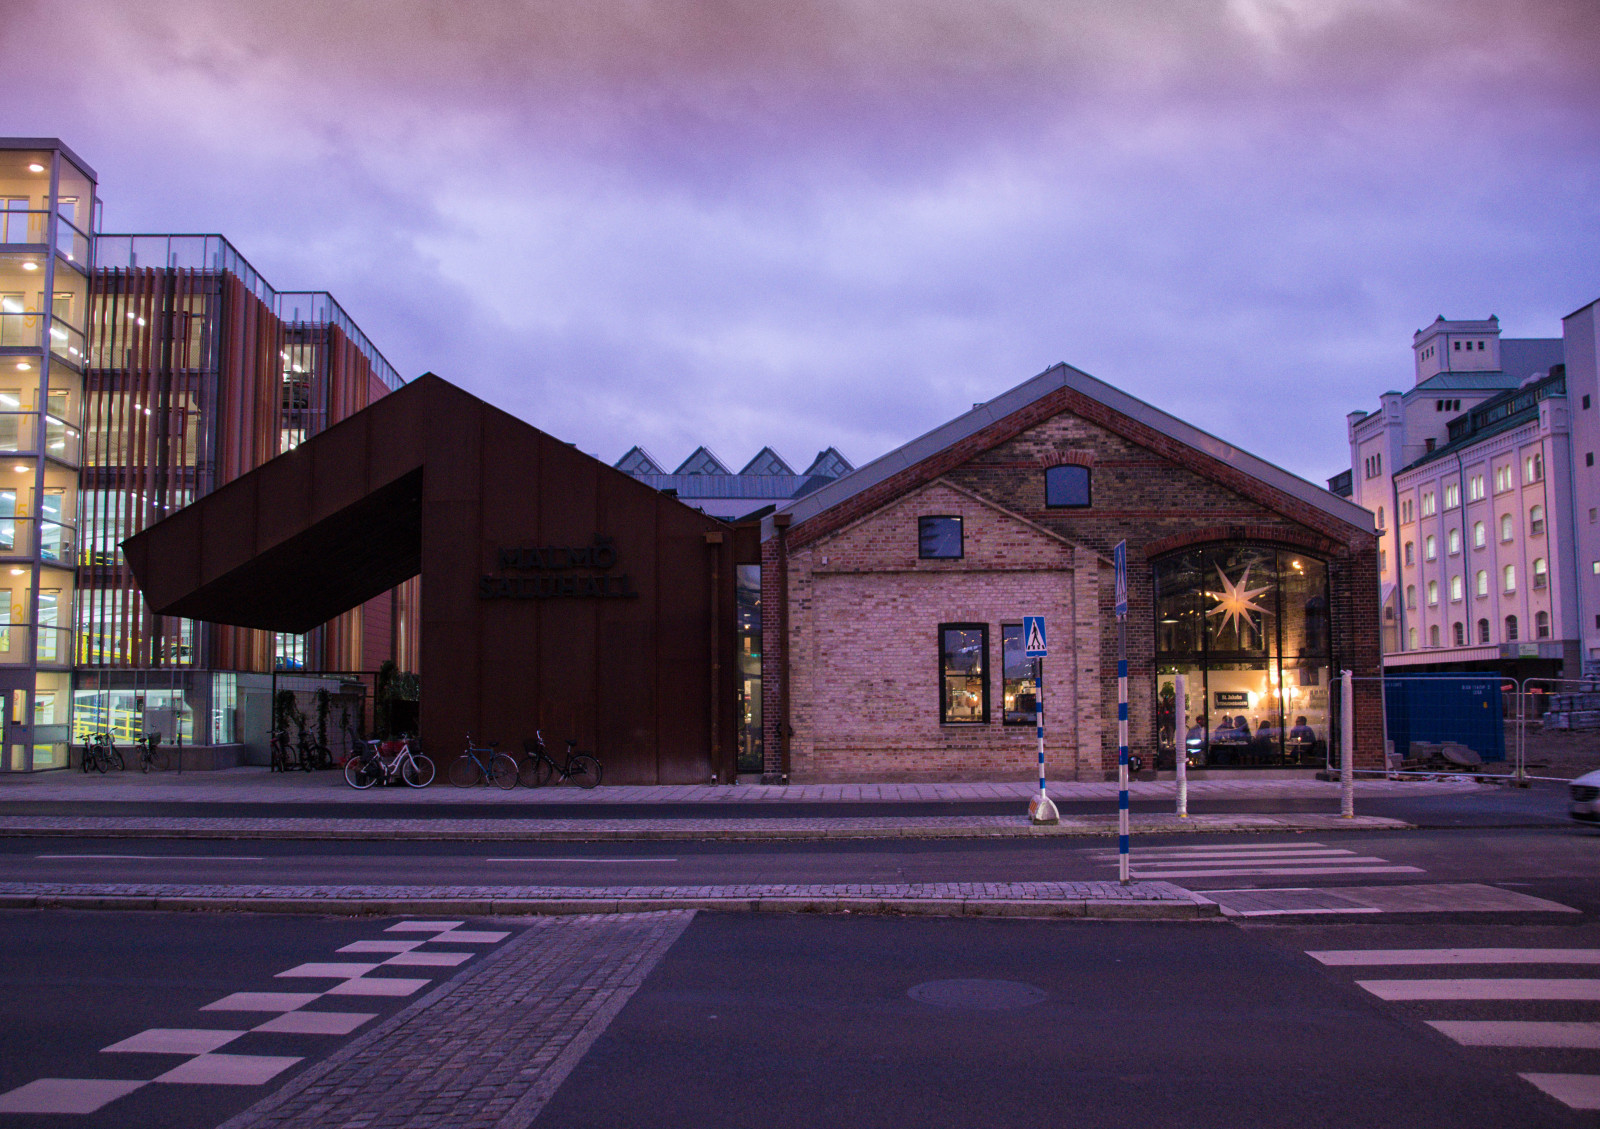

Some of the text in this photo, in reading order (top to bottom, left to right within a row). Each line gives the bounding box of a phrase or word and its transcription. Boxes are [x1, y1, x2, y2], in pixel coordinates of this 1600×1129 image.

[29, 212, 42, 231] 11
[25, 306, 37, 329] 9
[21, 404, 33, 425] 7
[17, 504, 28, 525] 5
[497, 533, 617, 569] MALMÖ
[478, 573, 639, 600] SALUHALL
[12, 604, 24, 625] 3
